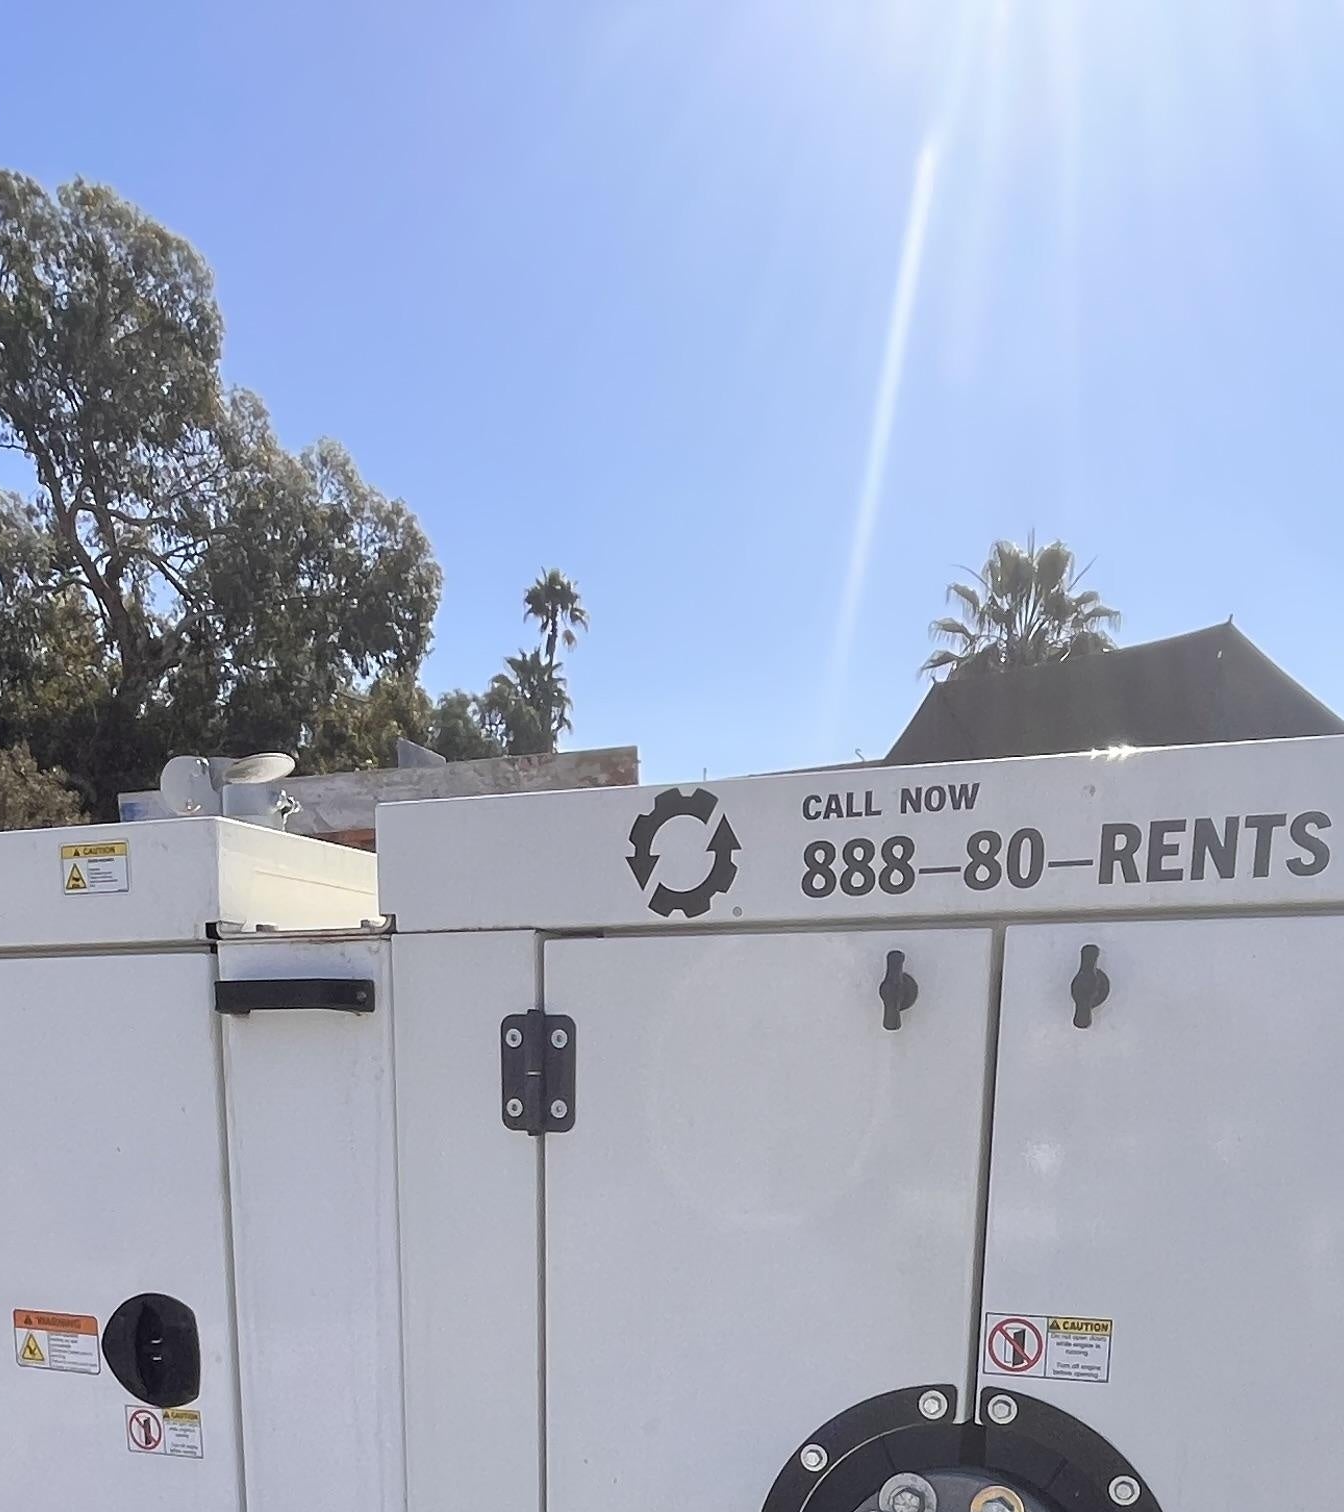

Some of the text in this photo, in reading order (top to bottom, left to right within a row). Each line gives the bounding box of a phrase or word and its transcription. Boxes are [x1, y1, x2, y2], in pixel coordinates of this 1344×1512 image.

[802, 782, 980, 820] CALL NOW
[37, 1315, 82, 1329] WARNING
[1062, 1321, 1109, 1332] CAUTION
